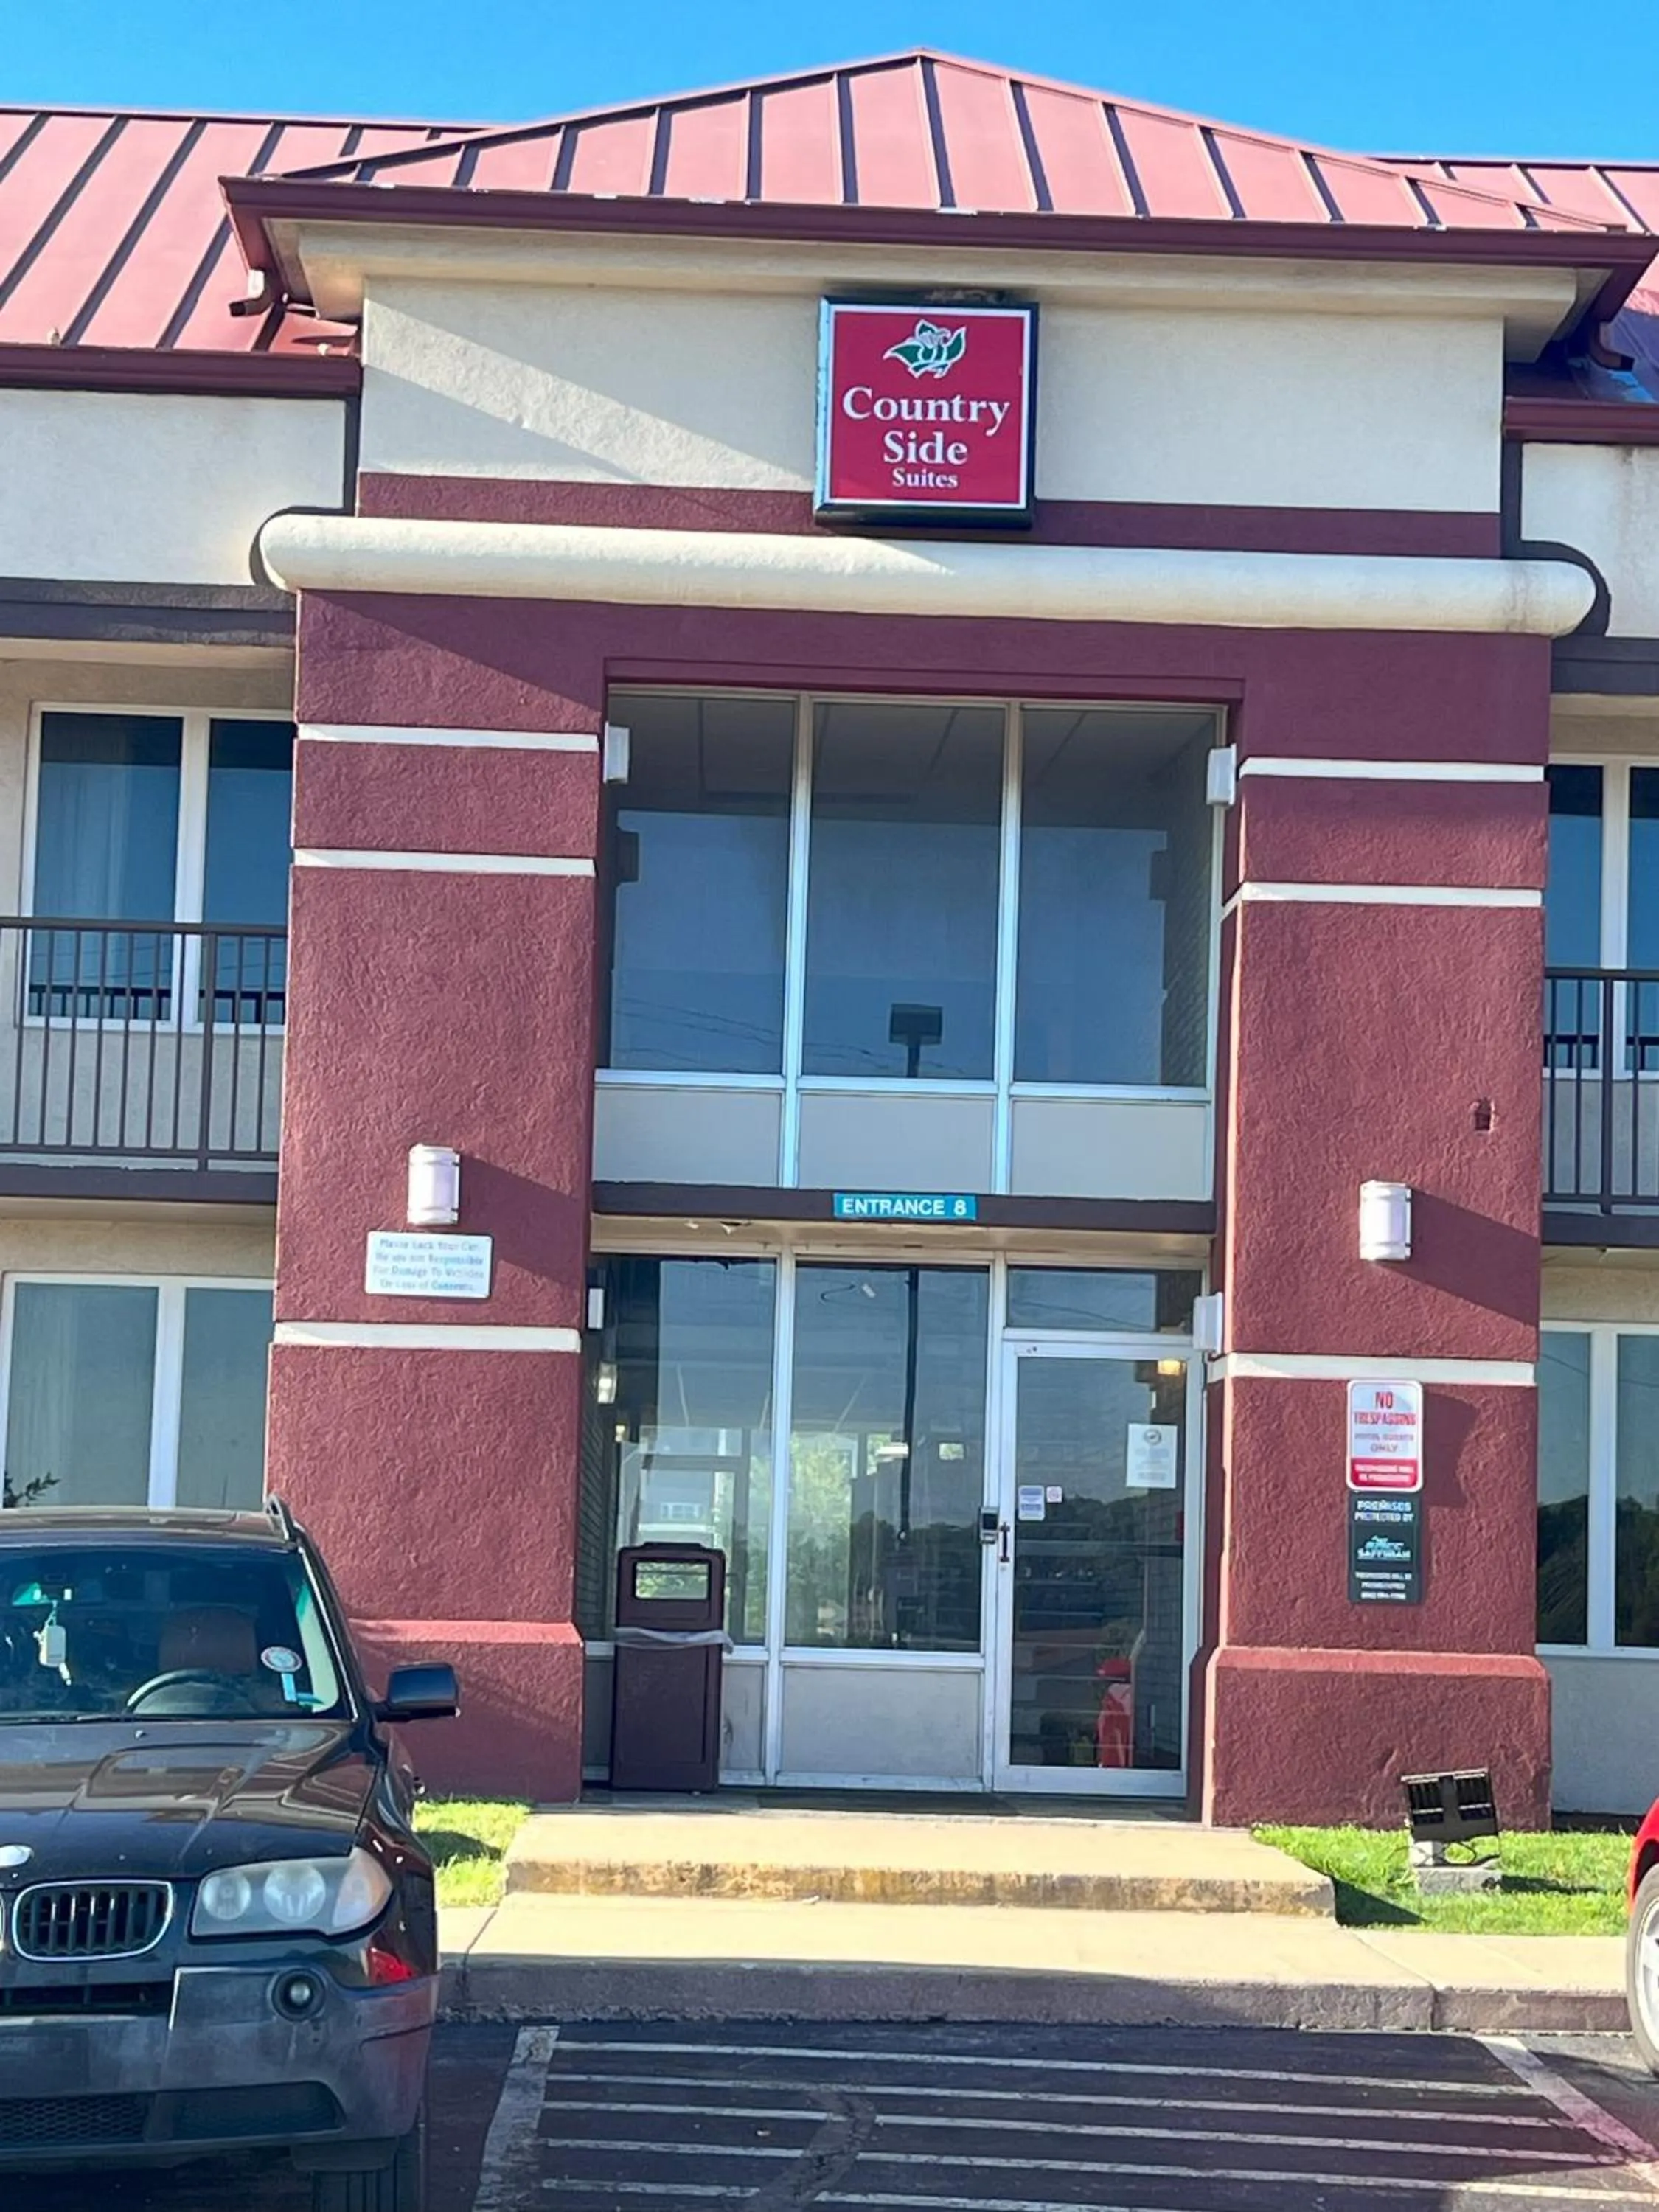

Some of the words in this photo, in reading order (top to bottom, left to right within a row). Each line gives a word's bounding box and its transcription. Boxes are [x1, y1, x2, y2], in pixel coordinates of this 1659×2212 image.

[842, 386, 1010, 437] Country
[883, 430, 968, 465] Side
[891, 467, 959, 488] Suites
[842, 1198, 945, 1216] ENTRANCE
[953, 1200, 967, 1216] 8
[1375, 1391, 1394, 1409] NO
